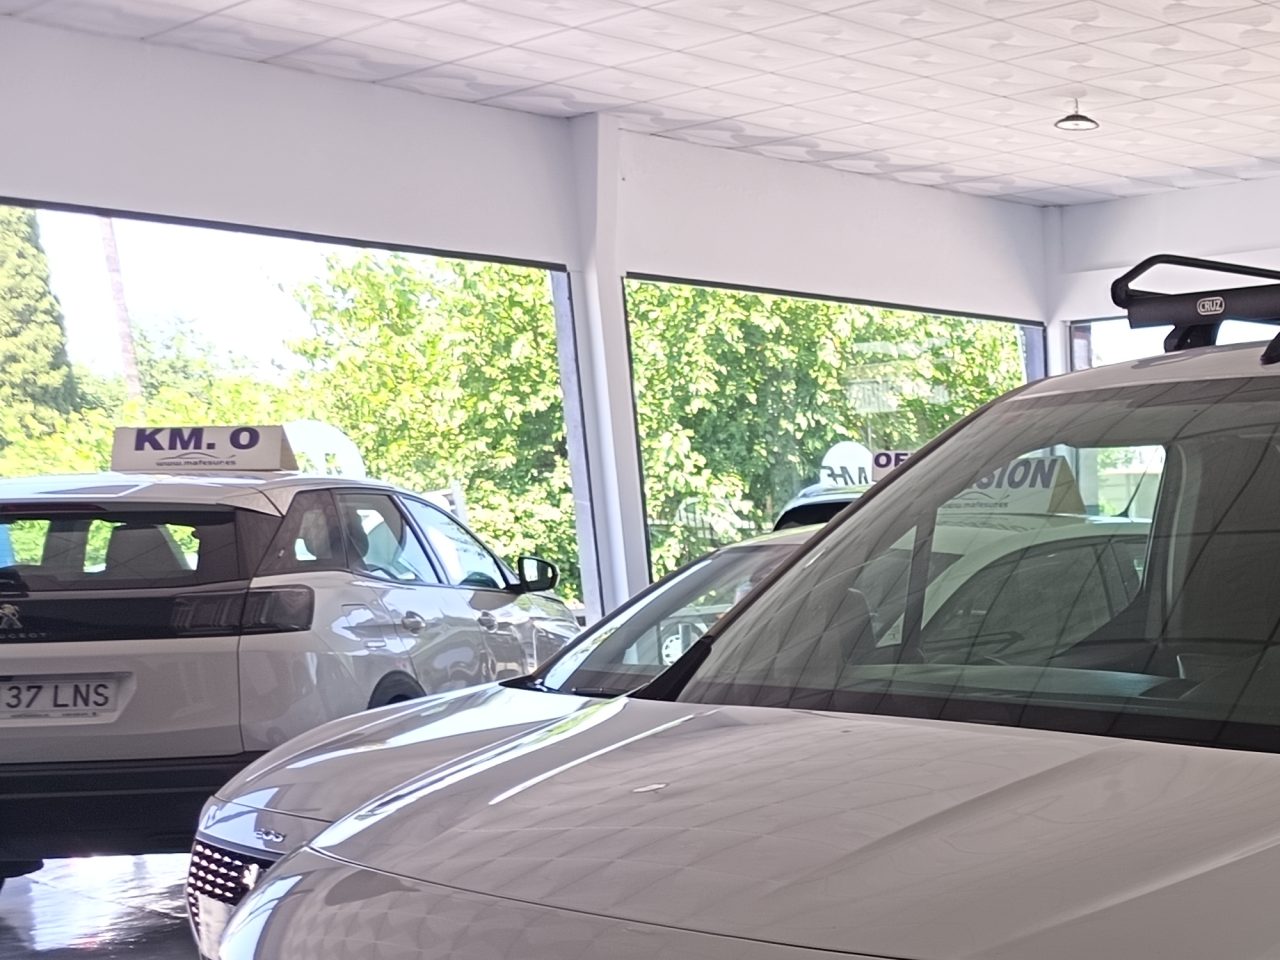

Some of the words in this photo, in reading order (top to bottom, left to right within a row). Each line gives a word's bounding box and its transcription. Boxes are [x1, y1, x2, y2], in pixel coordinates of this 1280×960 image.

[1200, 300, 1221, 311] CRUZ
[134, 427, 216, 451] KM.
[5, 685, 44, 709] 37
[52, 683, 110, 708] LNS
